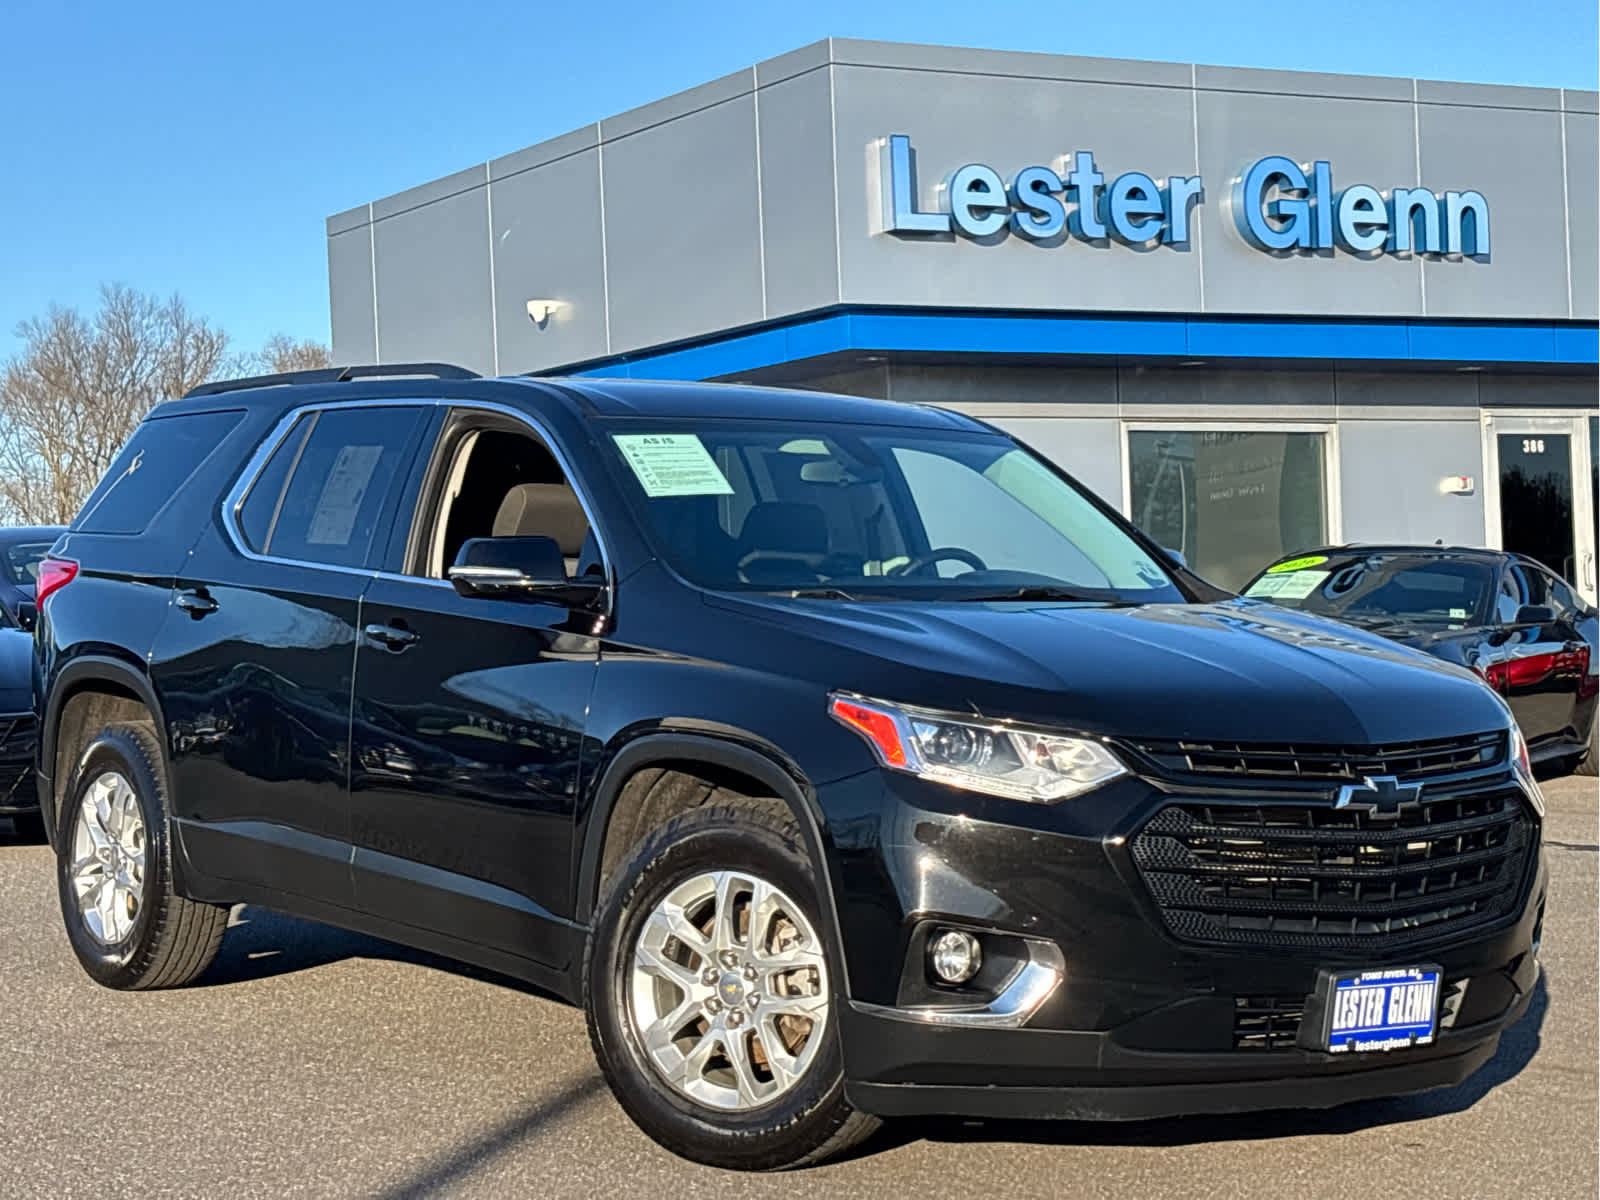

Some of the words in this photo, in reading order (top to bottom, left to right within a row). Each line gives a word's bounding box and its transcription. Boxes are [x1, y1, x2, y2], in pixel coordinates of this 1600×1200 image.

[888, 134, 1203, 243] Lester
[1240, 155, 1491, 257] Glenn
[643, 437, 660, 445] AS
[661, 437, 675, 445] IS
[1361, 971, 1384, 980] TOMS
[1332, 988, 1386, 1030] LESTER
[1387, 983, 1433, 1025] GLENN
[1354, 1038, 1410, 1052] lesterglenn
